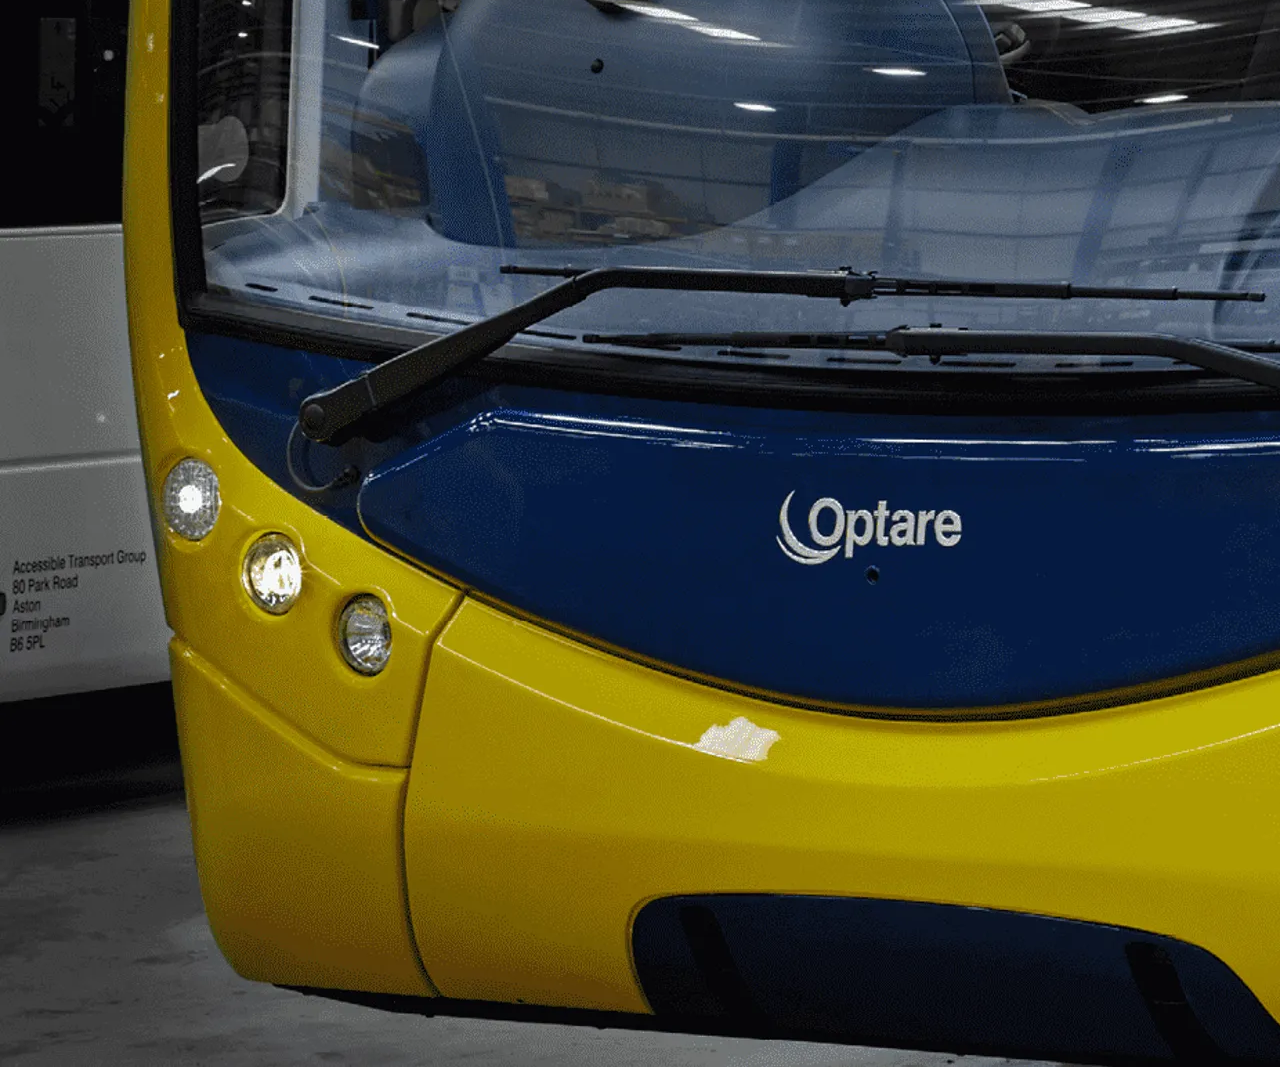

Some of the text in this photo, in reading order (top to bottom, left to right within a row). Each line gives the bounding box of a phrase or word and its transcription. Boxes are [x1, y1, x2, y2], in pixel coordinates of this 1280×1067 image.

[807, 496, 963, 559] Optare
[13, 549, 146, 574] Accessible Transport Group
[28, 576, 50, 593] Park
[53, 573, 79, 590] Road
[12, 599, 41, 614] Aston
[11, 615, 70, 633] Birmingham
